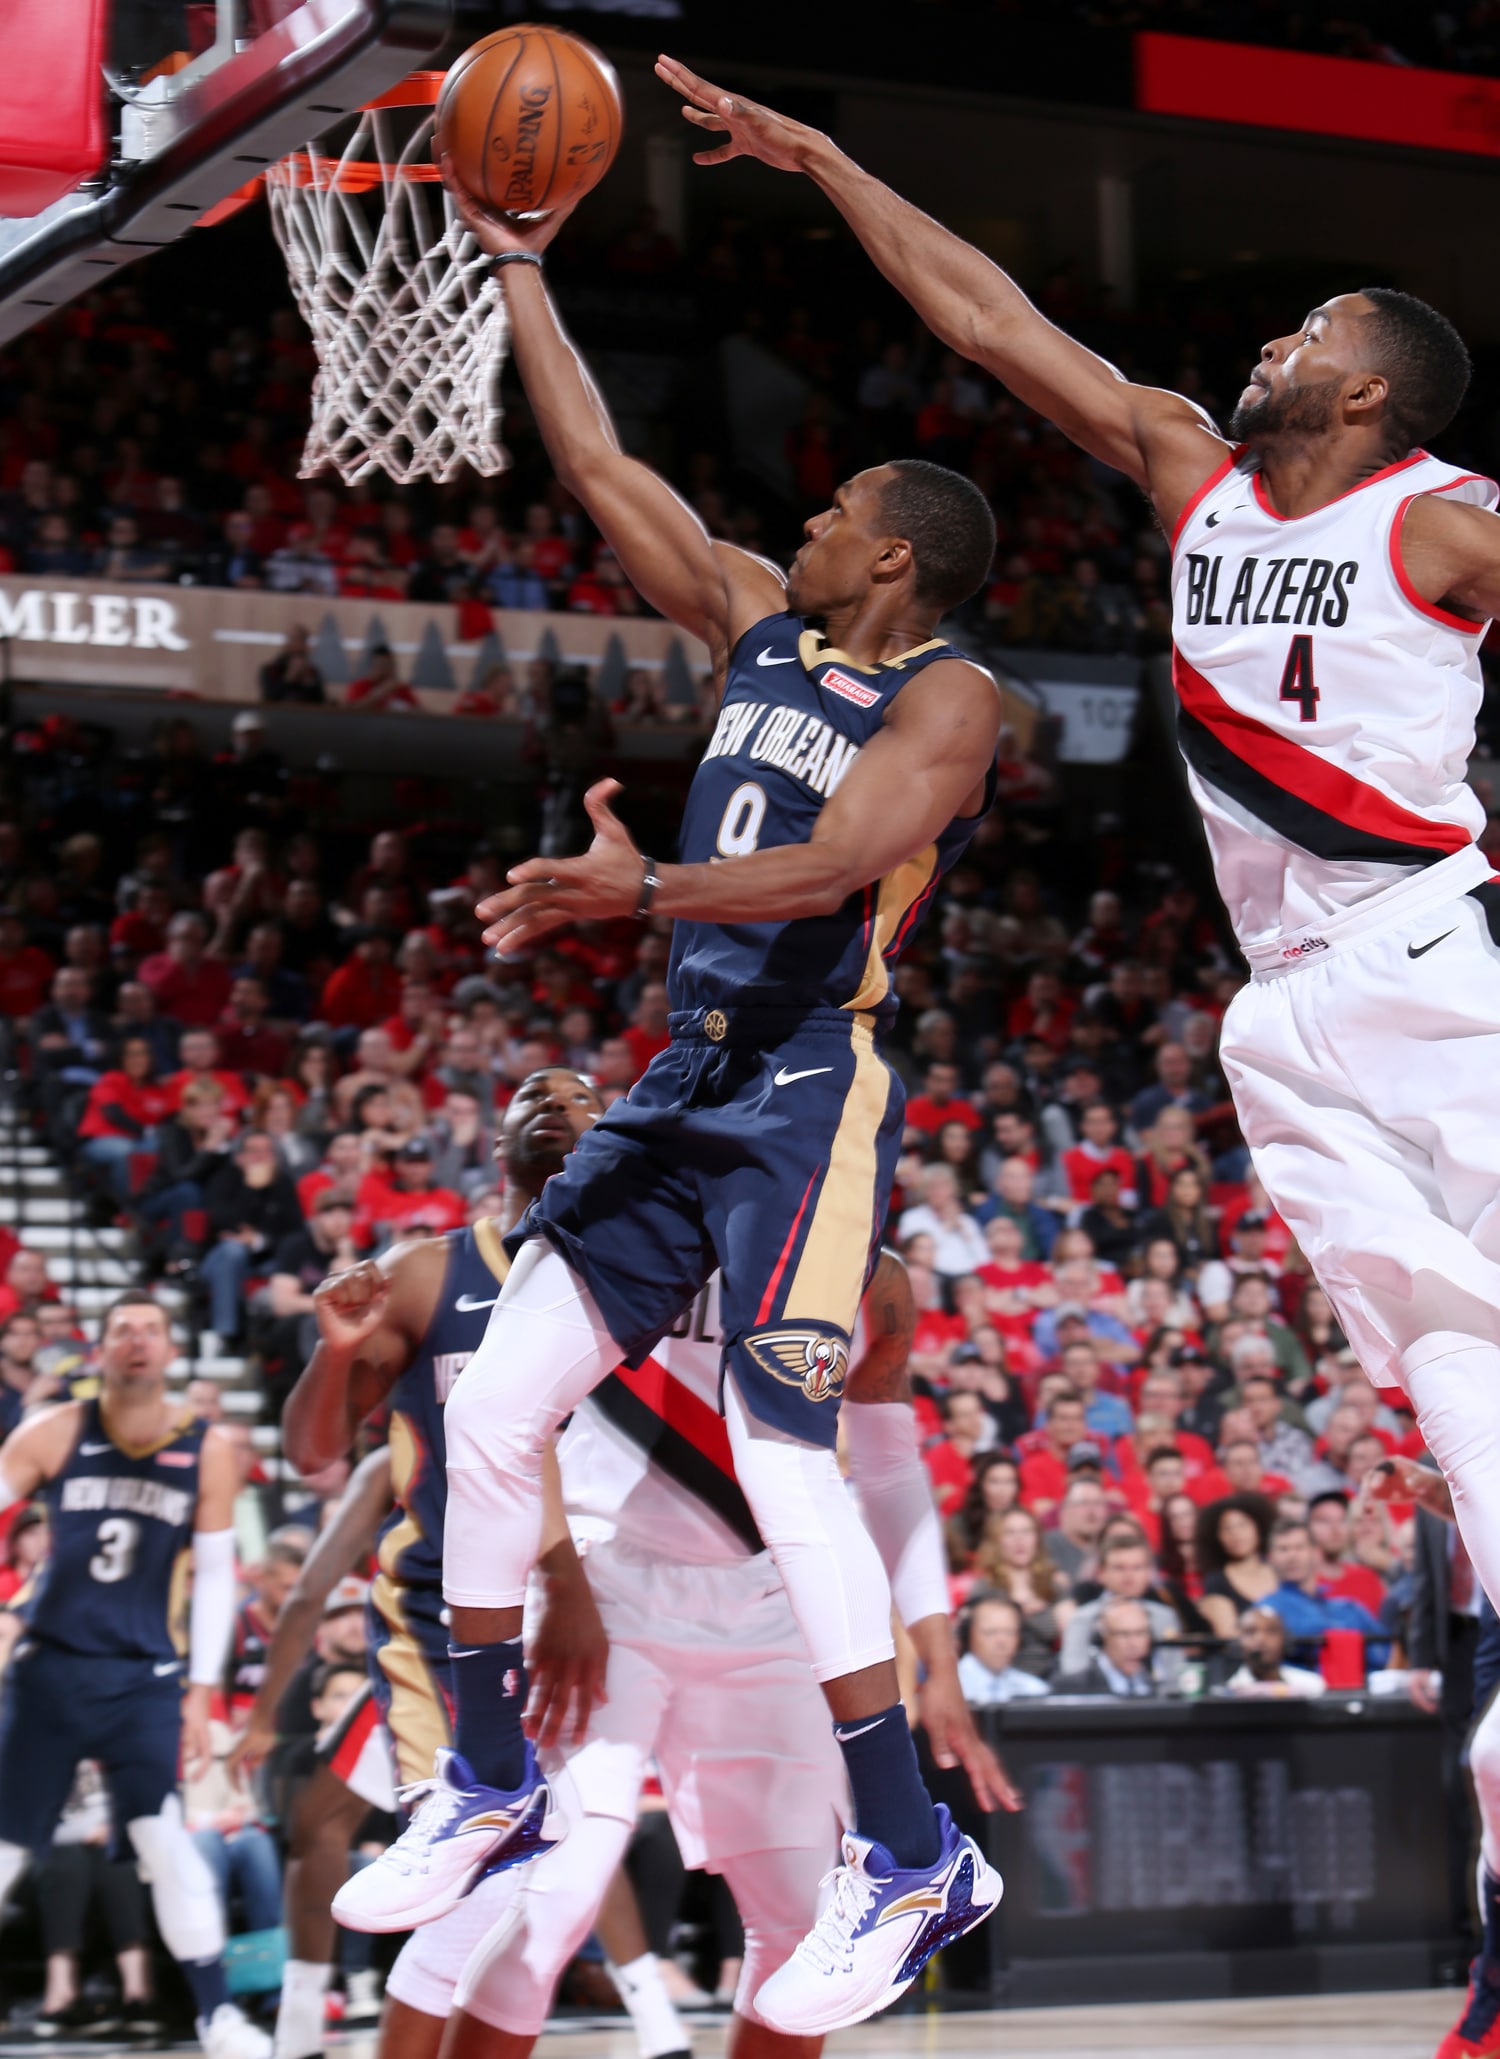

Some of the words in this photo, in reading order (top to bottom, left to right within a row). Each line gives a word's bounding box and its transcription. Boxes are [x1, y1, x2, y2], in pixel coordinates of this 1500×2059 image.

[0, 587, 191, 651] MLER
[1186, 553, 1359, 628] BLAZERS
[1279, 634, 1321, 722] 4
[700, 702, 768, 765] NEW
[89, 1517, 141, 1584] 3
